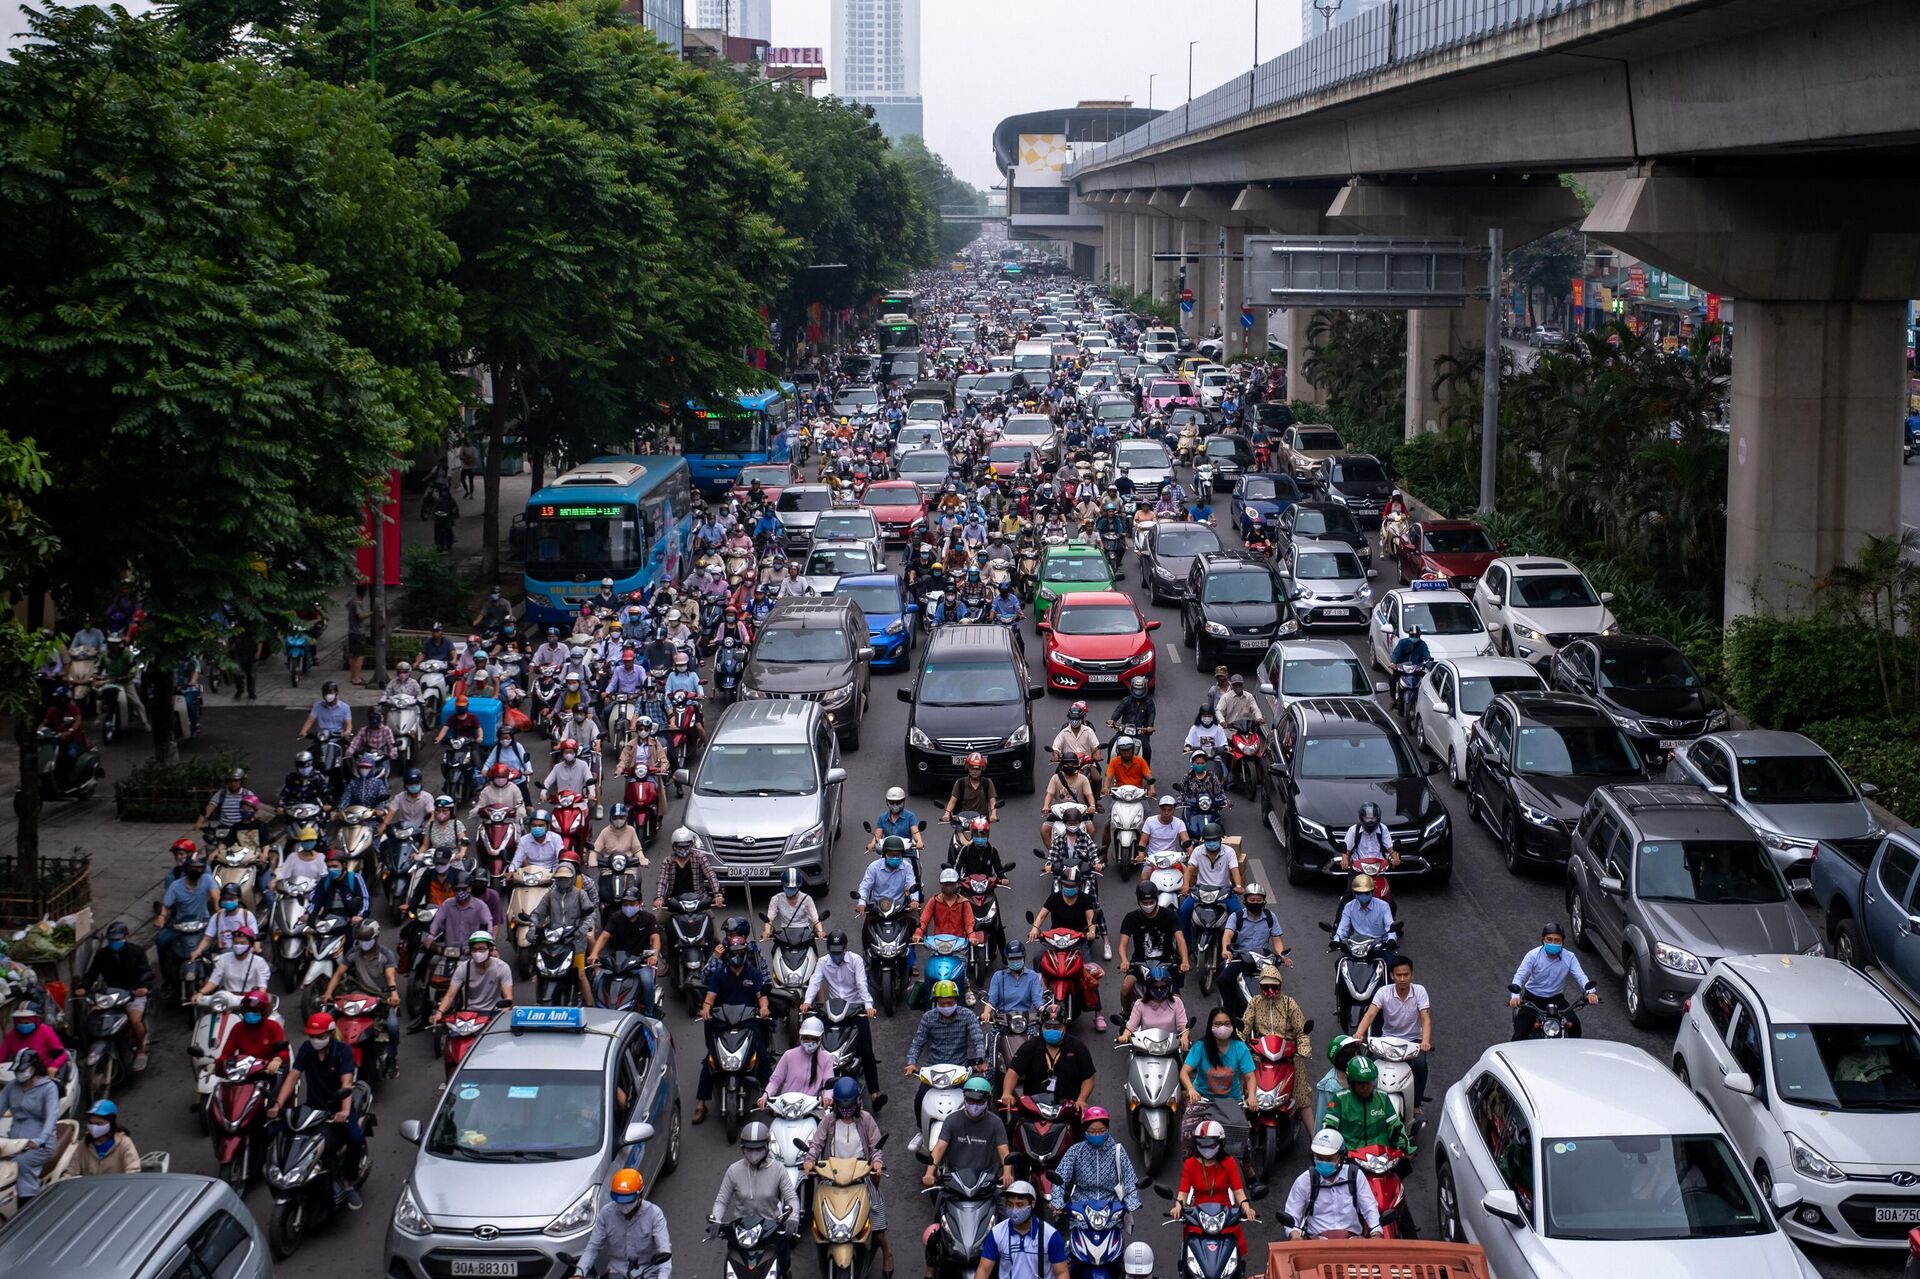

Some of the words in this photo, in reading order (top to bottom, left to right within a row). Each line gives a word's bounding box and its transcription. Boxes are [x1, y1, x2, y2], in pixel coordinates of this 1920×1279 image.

[767, 47, 823, 63] HOTEL
[527, 1010, 546, 1020] Lan
[547, 1010, 568, 1020] Anh
[1370, 1108, 1385, 1116] Grab
[453, 1262, 515, 1275] 30A-883.01
